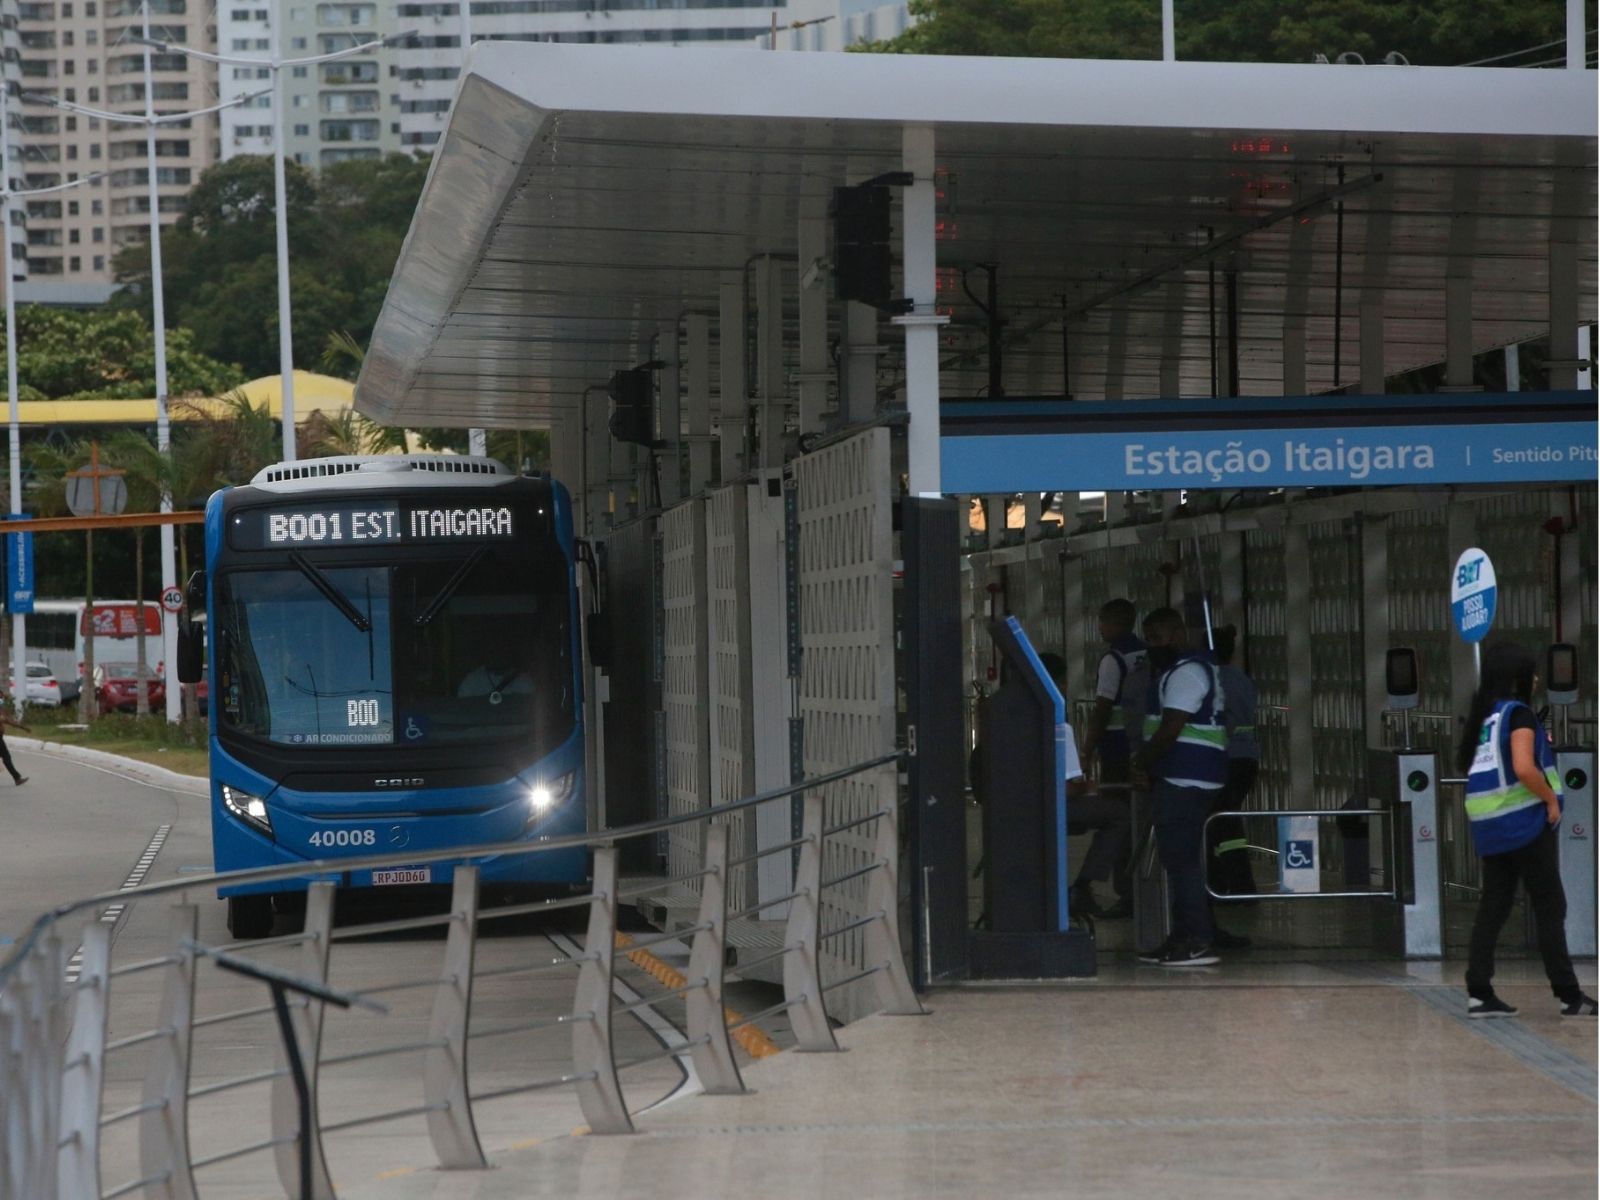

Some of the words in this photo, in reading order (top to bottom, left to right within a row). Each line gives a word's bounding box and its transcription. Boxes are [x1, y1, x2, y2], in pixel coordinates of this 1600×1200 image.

[1125, 441, 1271, 482] Estação
[1284, 438, 1435, 479] Itaigara
[1492, 446, 1564, 463] Sentido
[351, 511, 401, 538] EST.
[410, 507, 512, 537] ITAIGARA
[1457, 557, 1484, 589] BRT
[164, 592, 182, 603] 40
[306, 734, 319, 743] AR
[320, 733, 391, 743] CONDICIONADO
[309, 829, 376, 847] 40008
